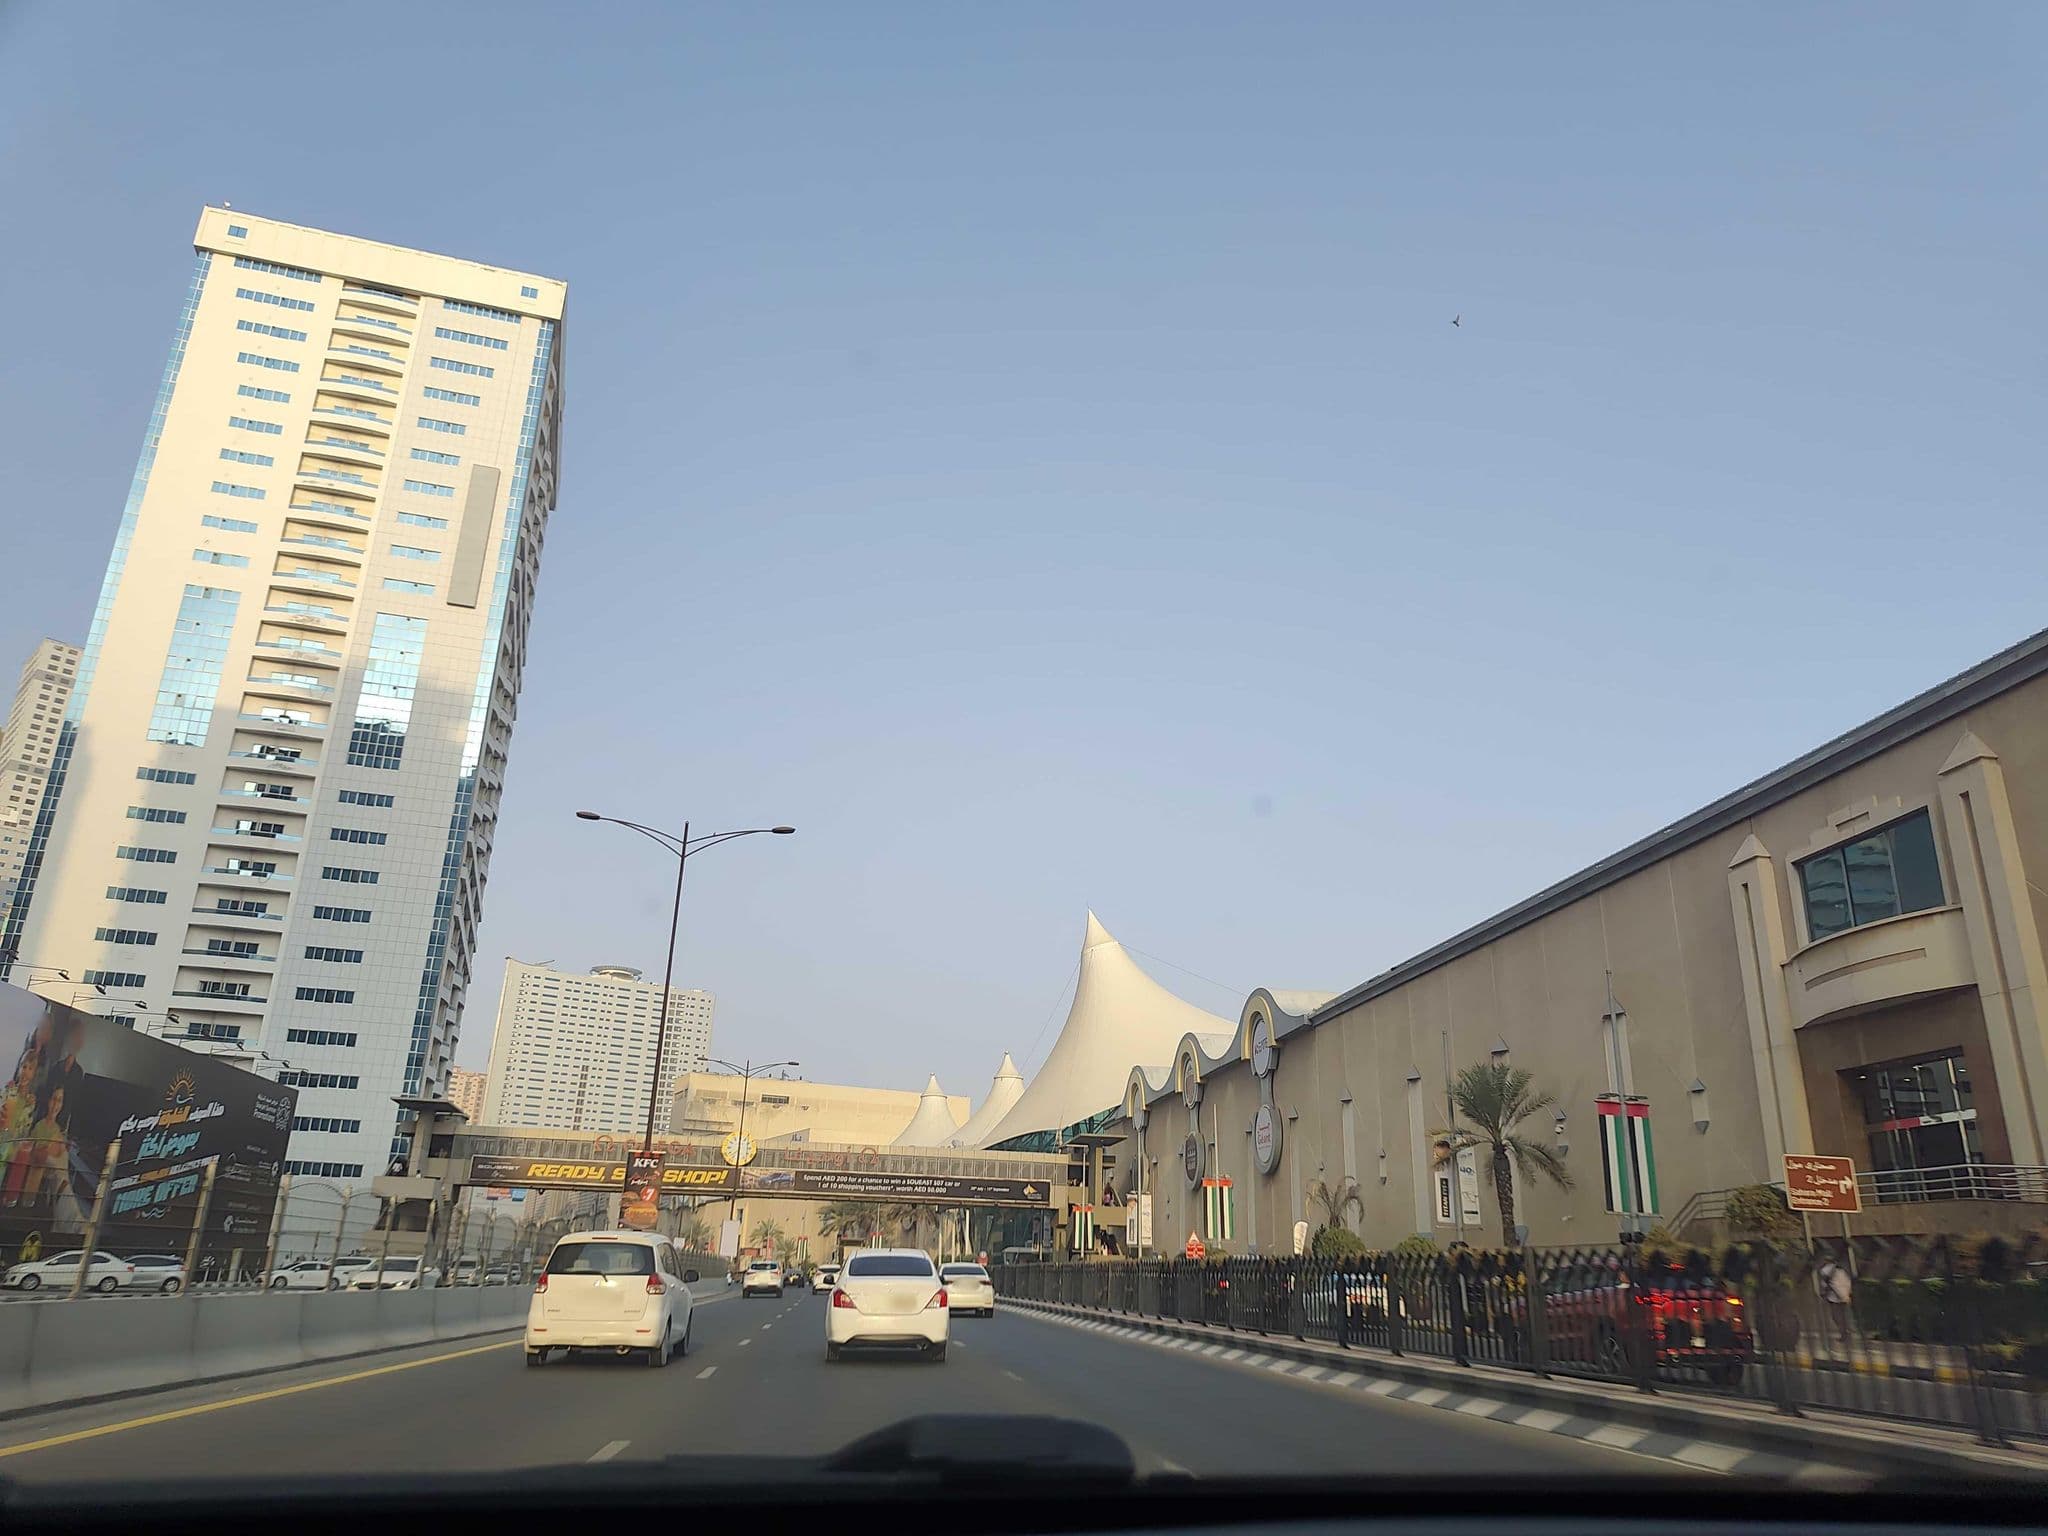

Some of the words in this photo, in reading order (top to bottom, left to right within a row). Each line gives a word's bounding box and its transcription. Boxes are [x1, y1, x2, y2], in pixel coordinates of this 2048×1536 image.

[633, 1158, 659, 1168] KFC
[527, 1163, 607, 1182] READY,
[662, 1169, 729, 1184] SHOP!
[803, 1174, 822, 1182] Spend
[862, 1176, 883, 1184] chance
[838, 1182, 865, 1192] shopping
